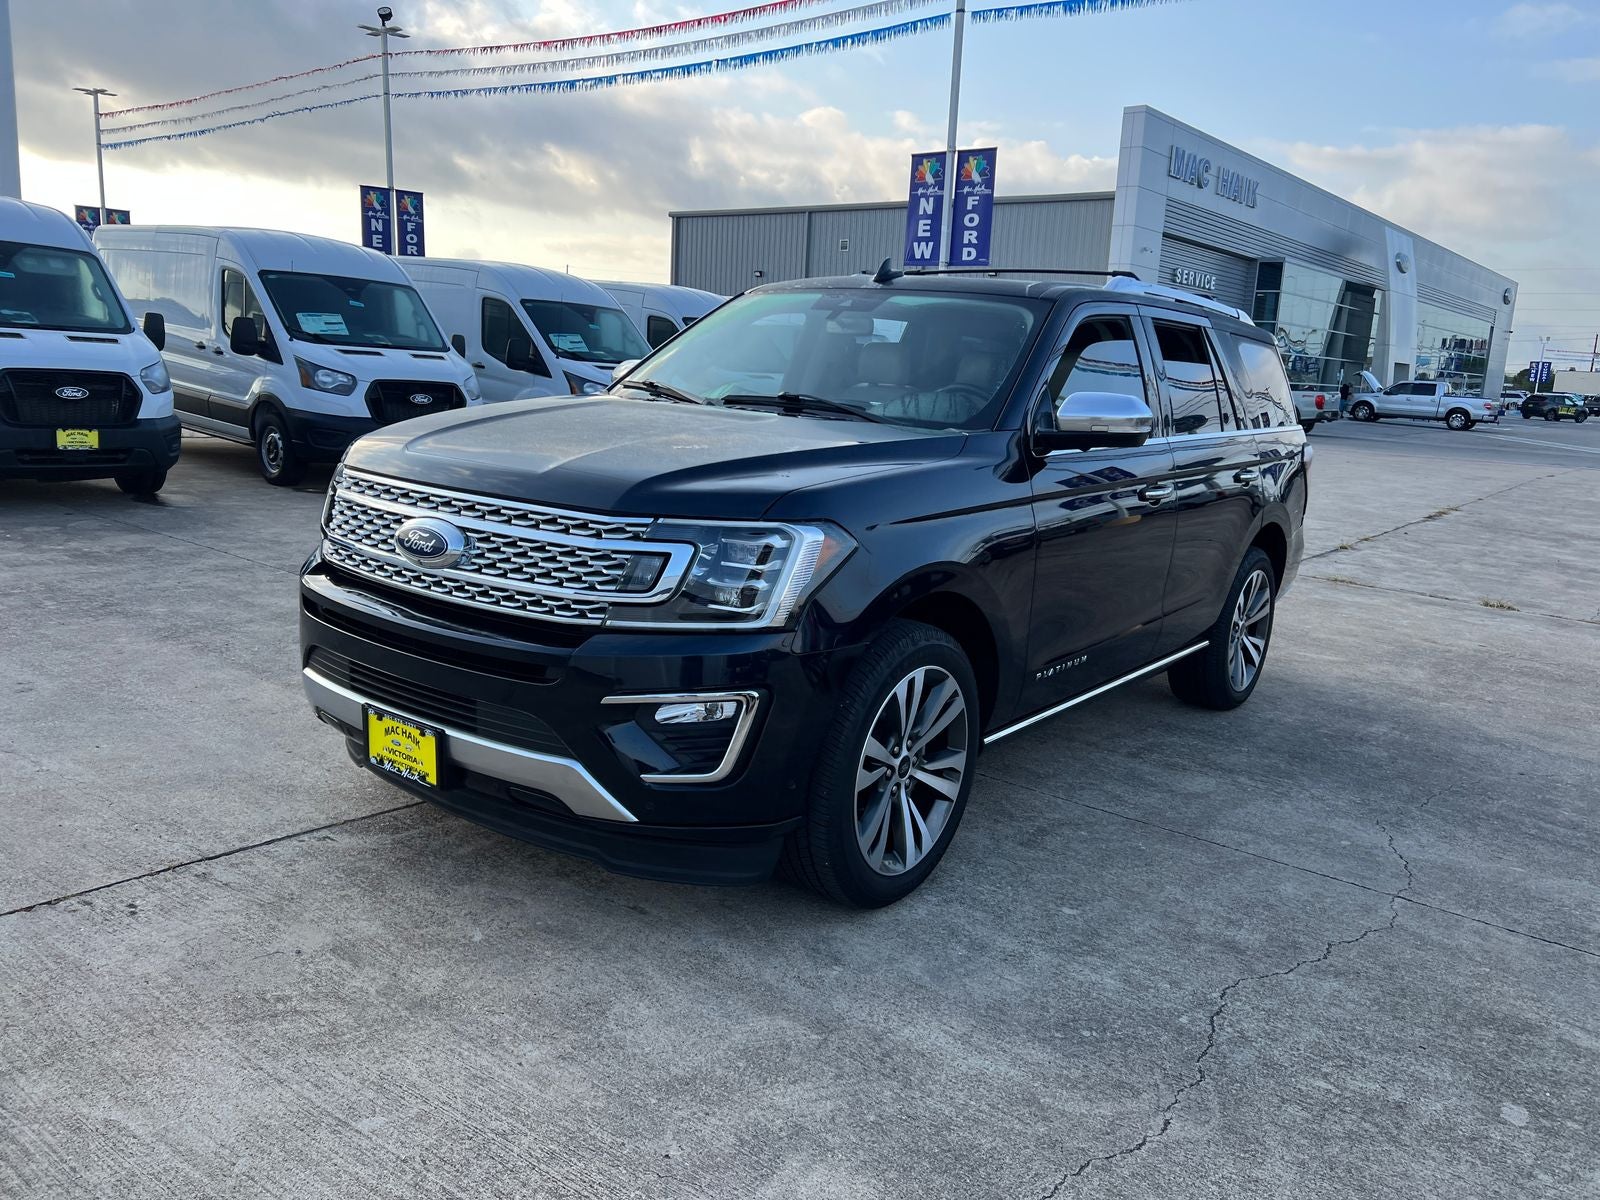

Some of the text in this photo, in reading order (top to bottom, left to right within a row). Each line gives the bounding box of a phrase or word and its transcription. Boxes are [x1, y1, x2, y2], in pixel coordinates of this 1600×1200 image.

[1168, 145, 1260, 208] MAC HAIK
[370, 218, 384, 248] NE
[406, 222, 418, 255] FOR
[913, 197, 934, 259] NEW
[962, 196, 980, 261] FORD
[1176, 268, 1216, 290] SERVICE
[404, 530, 436, 553] Ford
[384, 726, 421, 750] MAC HAIK
[388, 747, 418, 766] VICTORIA
